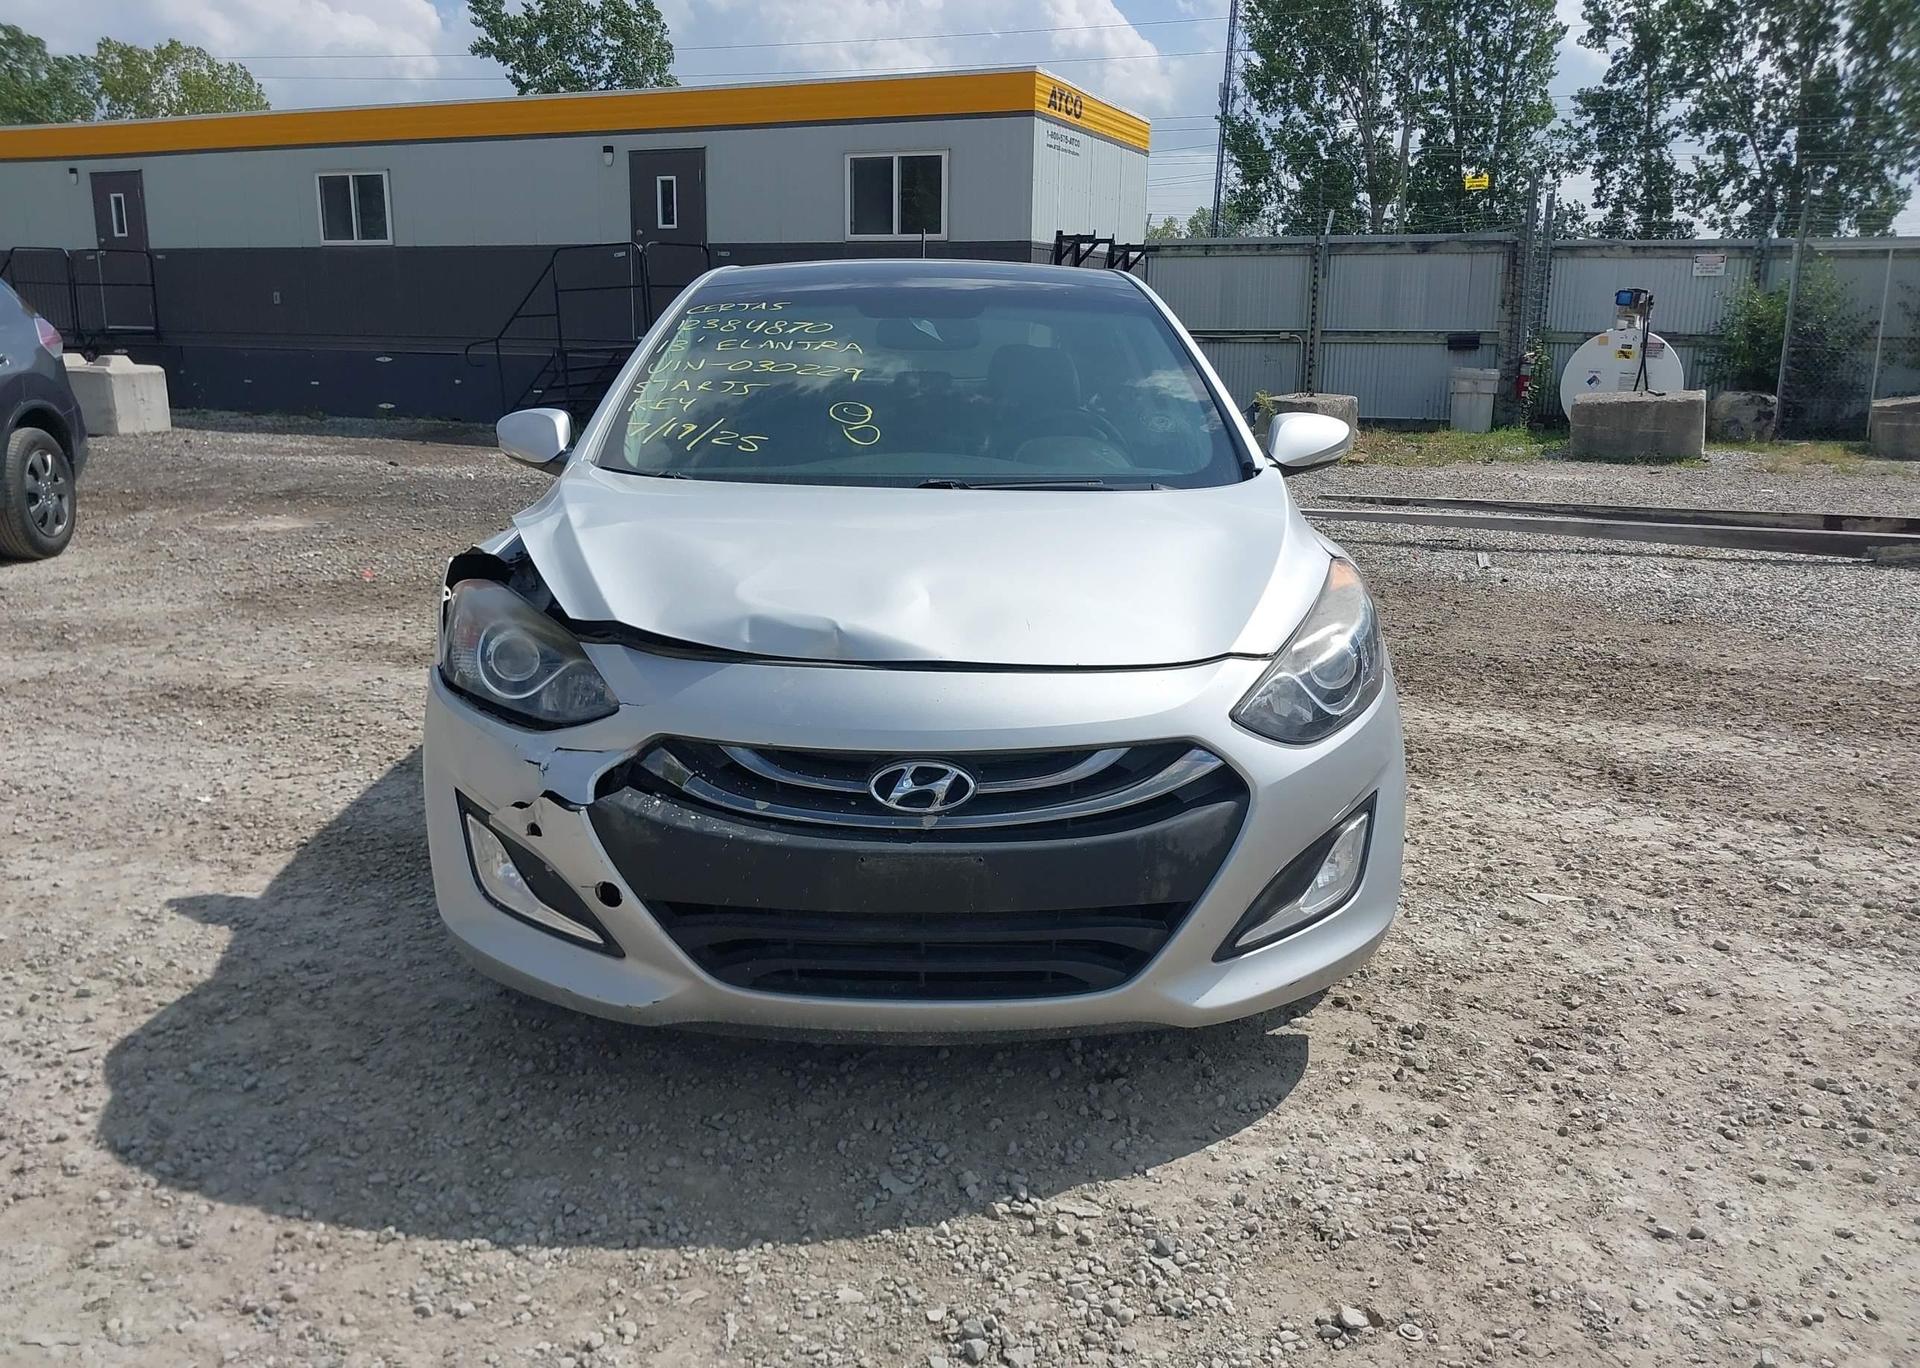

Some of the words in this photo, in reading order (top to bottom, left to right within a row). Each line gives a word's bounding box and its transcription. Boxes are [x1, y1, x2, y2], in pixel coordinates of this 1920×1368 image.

[1047, 85, 1083, 119] ATCO
[715, 338, 864, 354] ELANTRA
[627, 396, 697, 413] KEY
